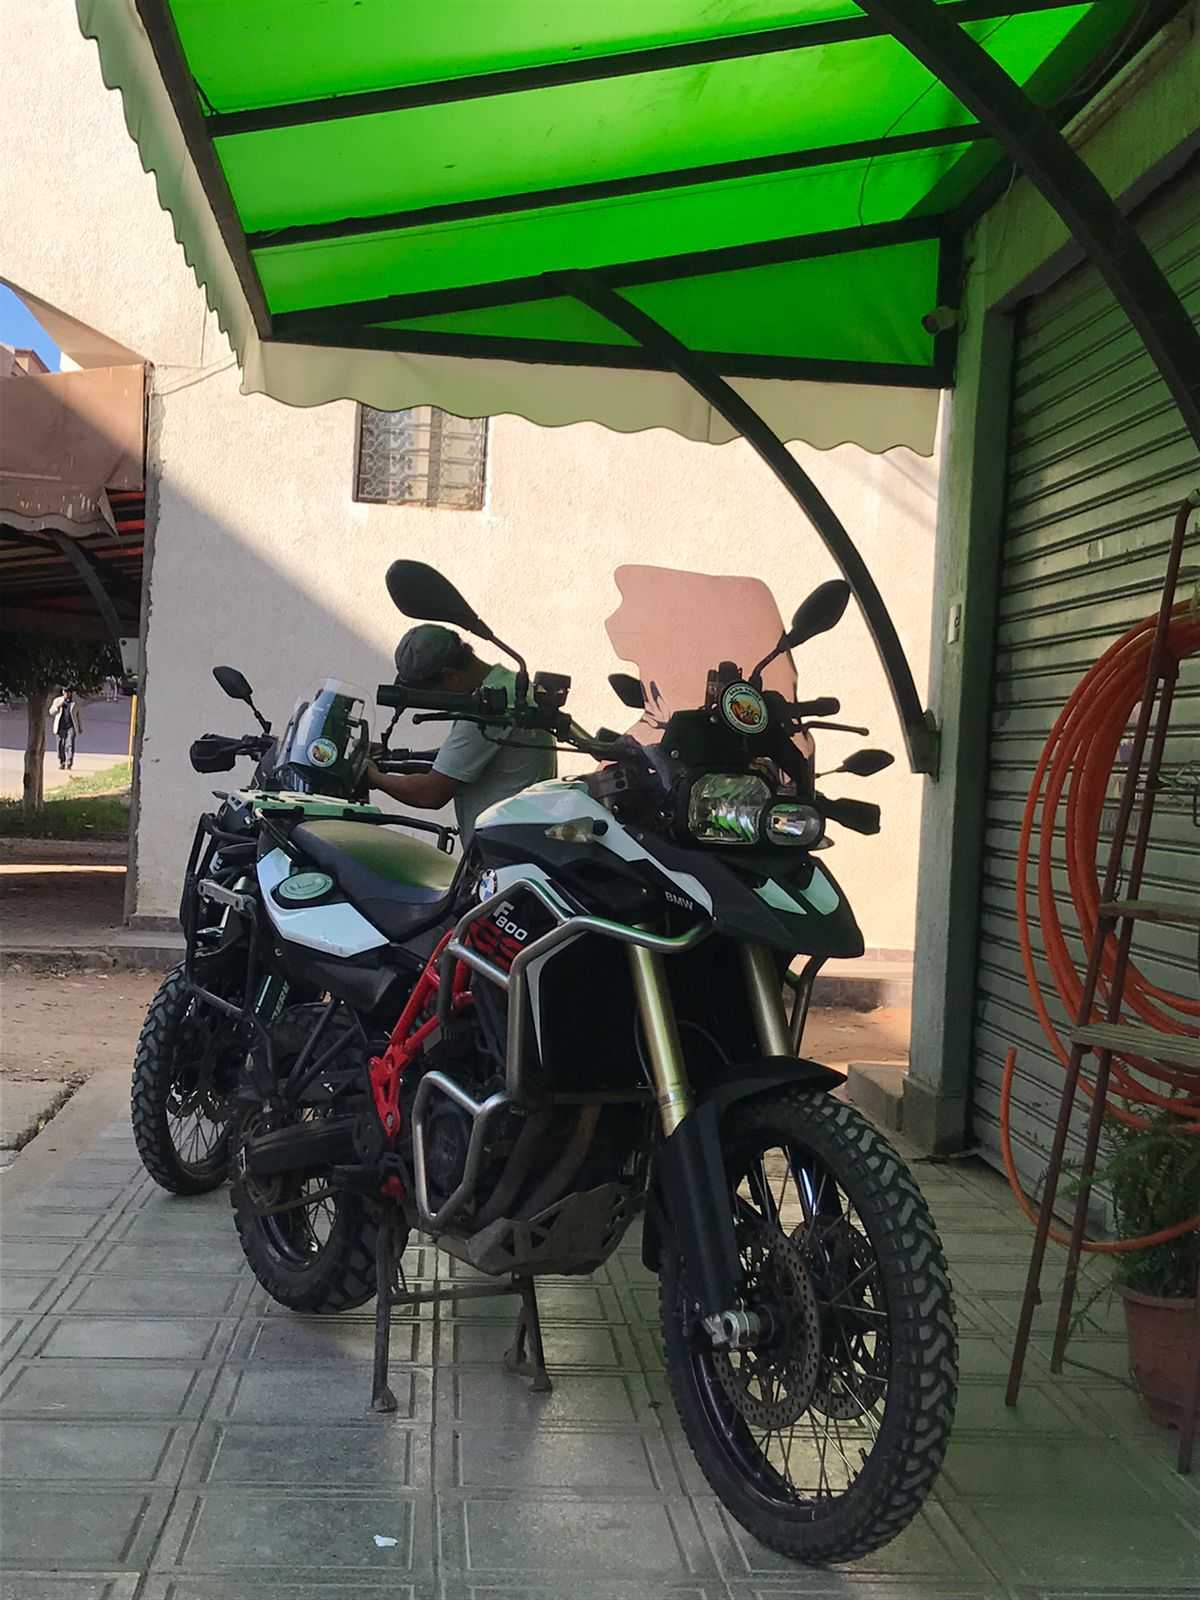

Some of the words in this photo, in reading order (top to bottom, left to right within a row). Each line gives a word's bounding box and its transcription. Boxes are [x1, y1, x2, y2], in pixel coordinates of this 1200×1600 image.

[493, 901, 515, 918] F
[664, 890, 694, 911] BMW
[495, 916, 528, 941] 800
